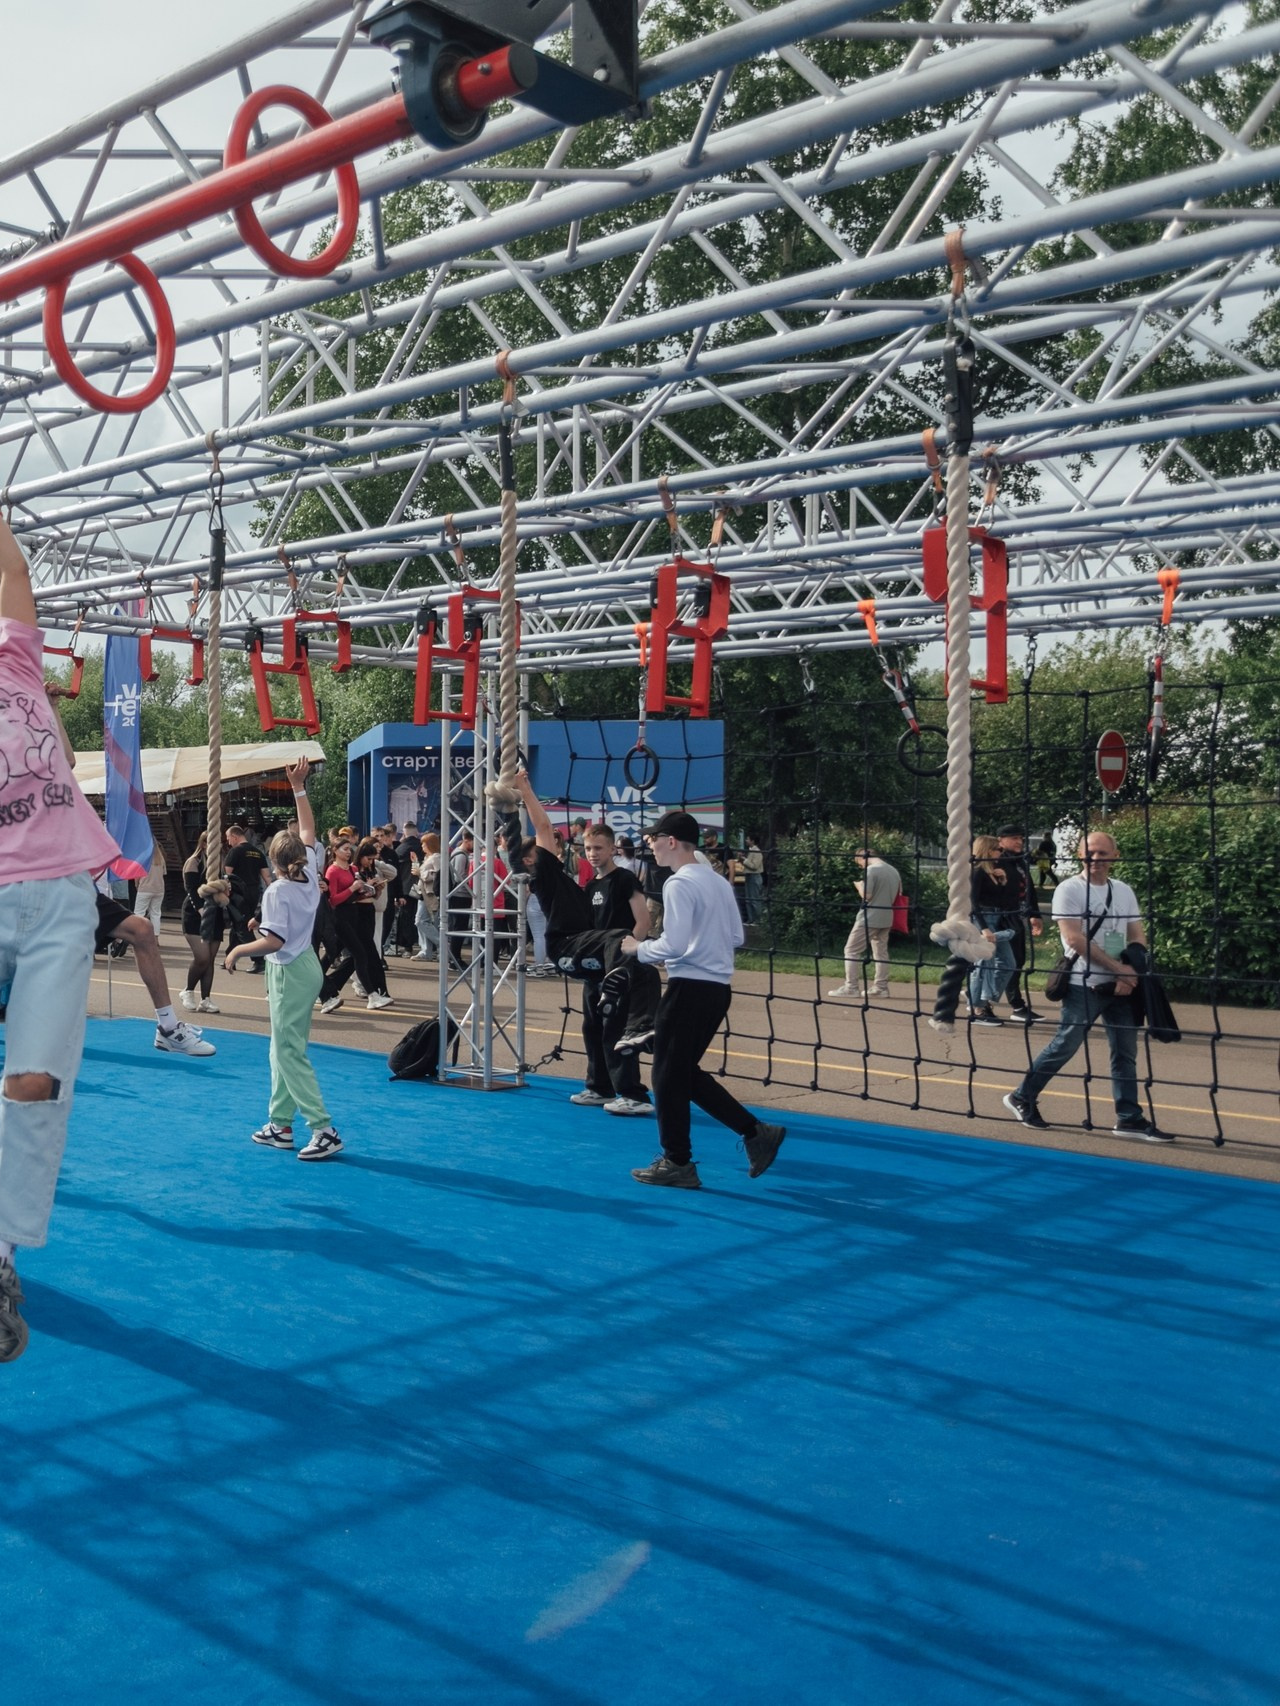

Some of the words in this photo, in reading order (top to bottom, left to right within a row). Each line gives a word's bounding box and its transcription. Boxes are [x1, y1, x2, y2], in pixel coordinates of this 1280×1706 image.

[105, 694, 137, 717] fe
[381, 755, 439, 772] старт
[607, 786, 658, 806] VK
